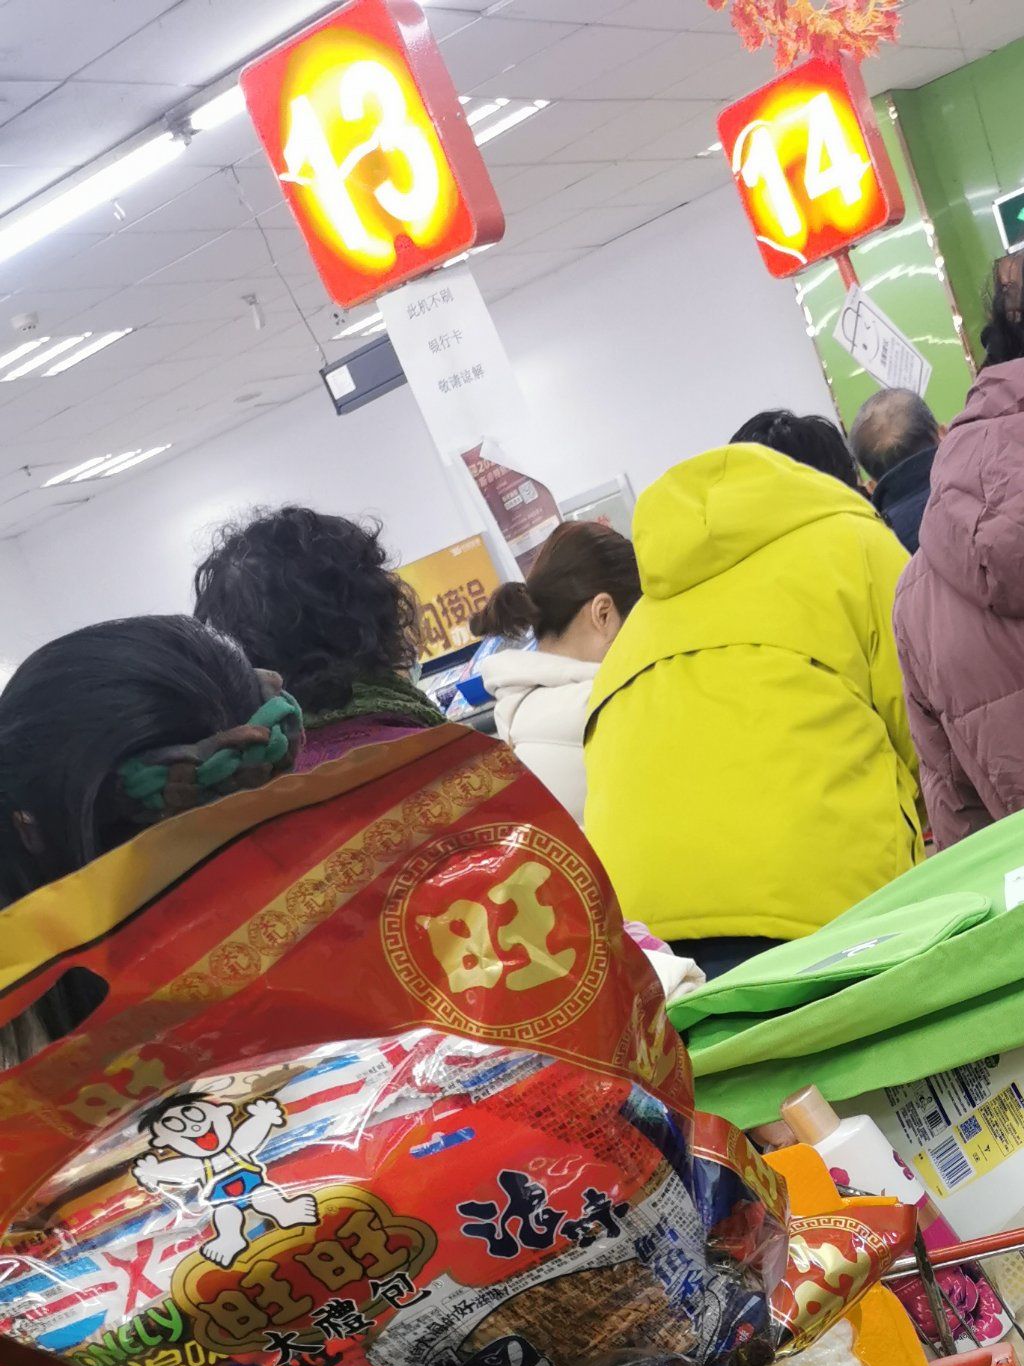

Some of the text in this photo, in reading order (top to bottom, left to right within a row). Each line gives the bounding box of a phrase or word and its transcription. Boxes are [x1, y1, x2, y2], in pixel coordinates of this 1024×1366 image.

[281, 60, 441, 260] 13
[742, 92, 871, 238] 14
[406, 287, 455, 319] 此机不刷
[428, 328, 463, 355] 银行卡
[422, 862, 578, 995] 旺
[194, 1208, 413, 1340] 旺旺
